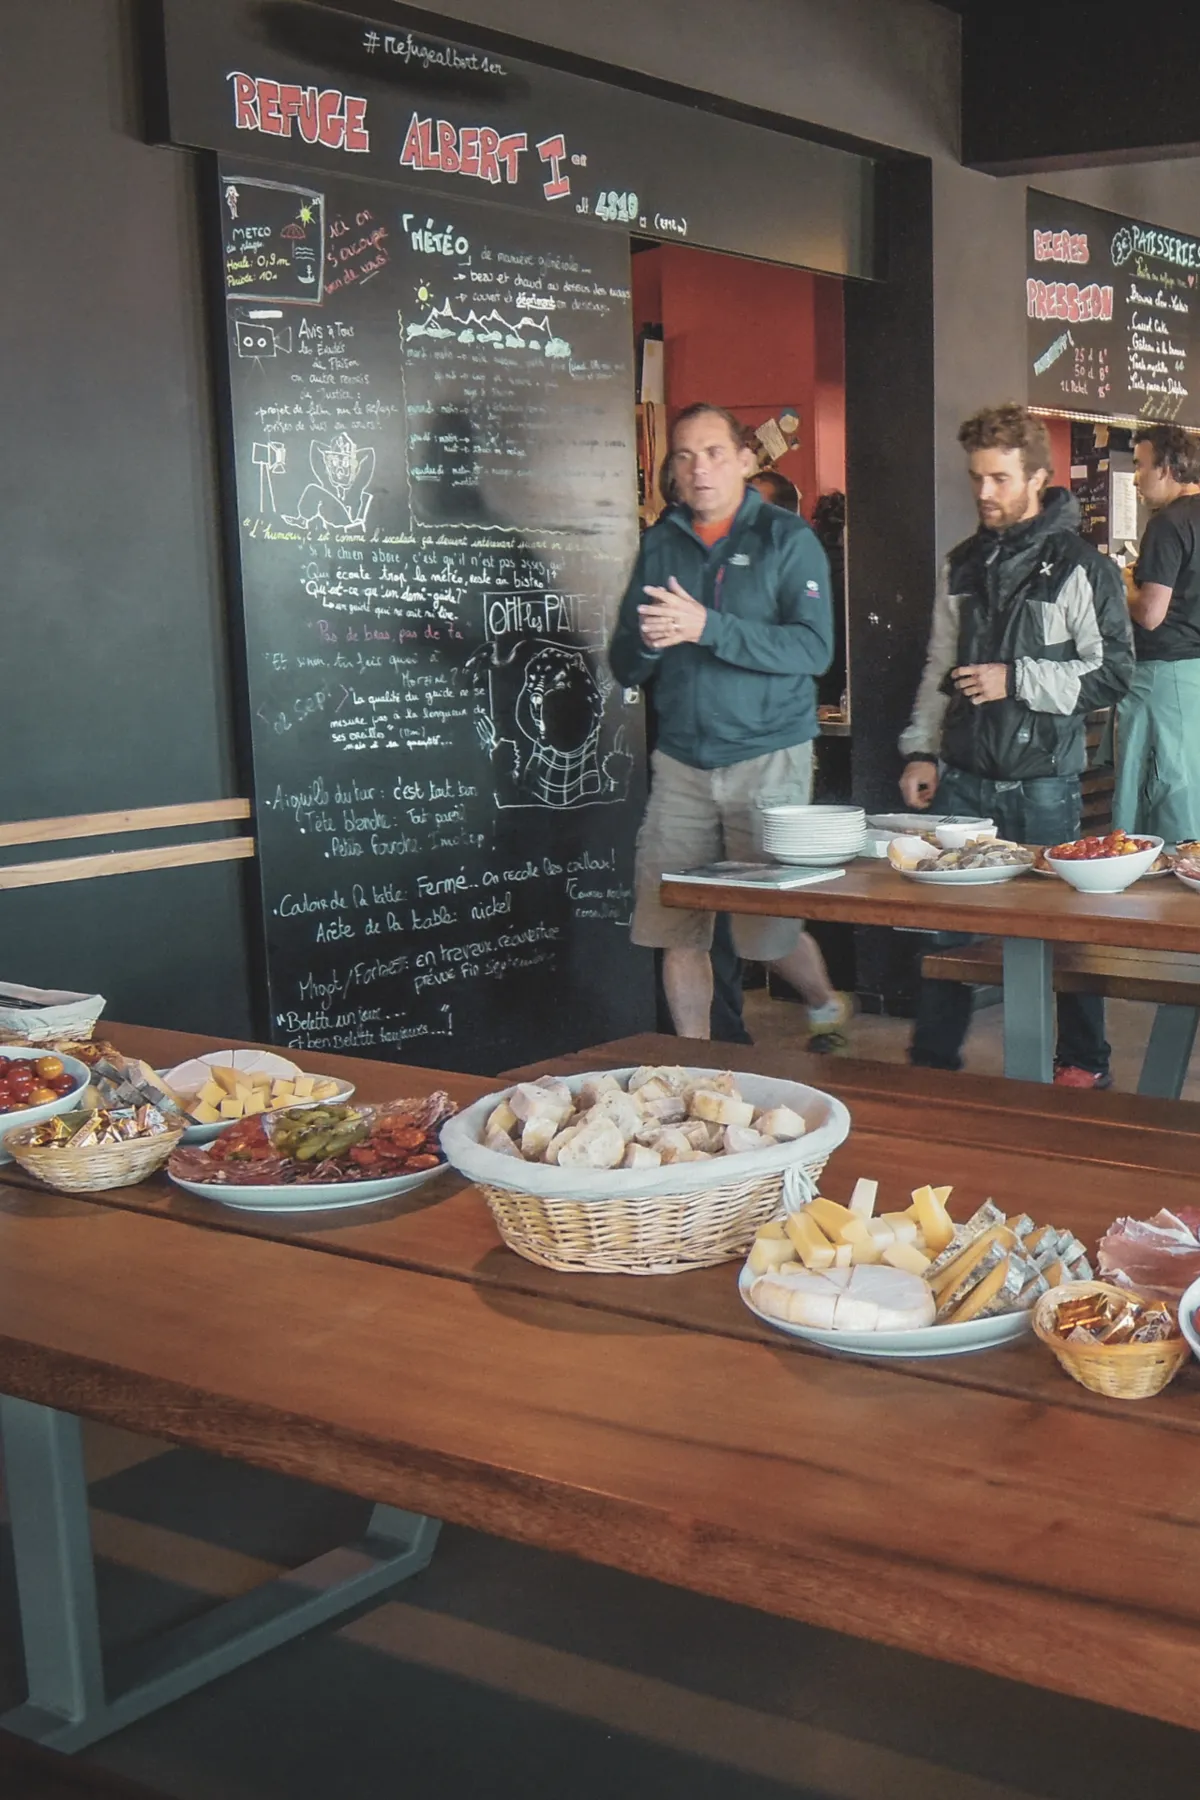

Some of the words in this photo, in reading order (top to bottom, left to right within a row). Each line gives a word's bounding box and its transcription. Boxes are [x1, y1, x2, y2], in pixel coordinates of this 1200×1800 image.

[227, 72, 370, 152] REFUGE
[400, 113, 527, 183] ALBERT
[595, 191, 638, 222] 4810
[411, 217, 469, 256] MÉTÉO
[1033, 229, 1089, 264] BIERES
[1026, 278, 1113, 323] PRESSION
[298, 318, 323, 339] Avis
[336, 566, 372, 580] écoute
[337, 547, 363, 561] chien
[499, 559, 516, 575] pas
[346, 626, 358, 641] de
[424, 624, 440, 640] de
[523, 601, 543, 633] les
[365, 918, 381, 936] de
